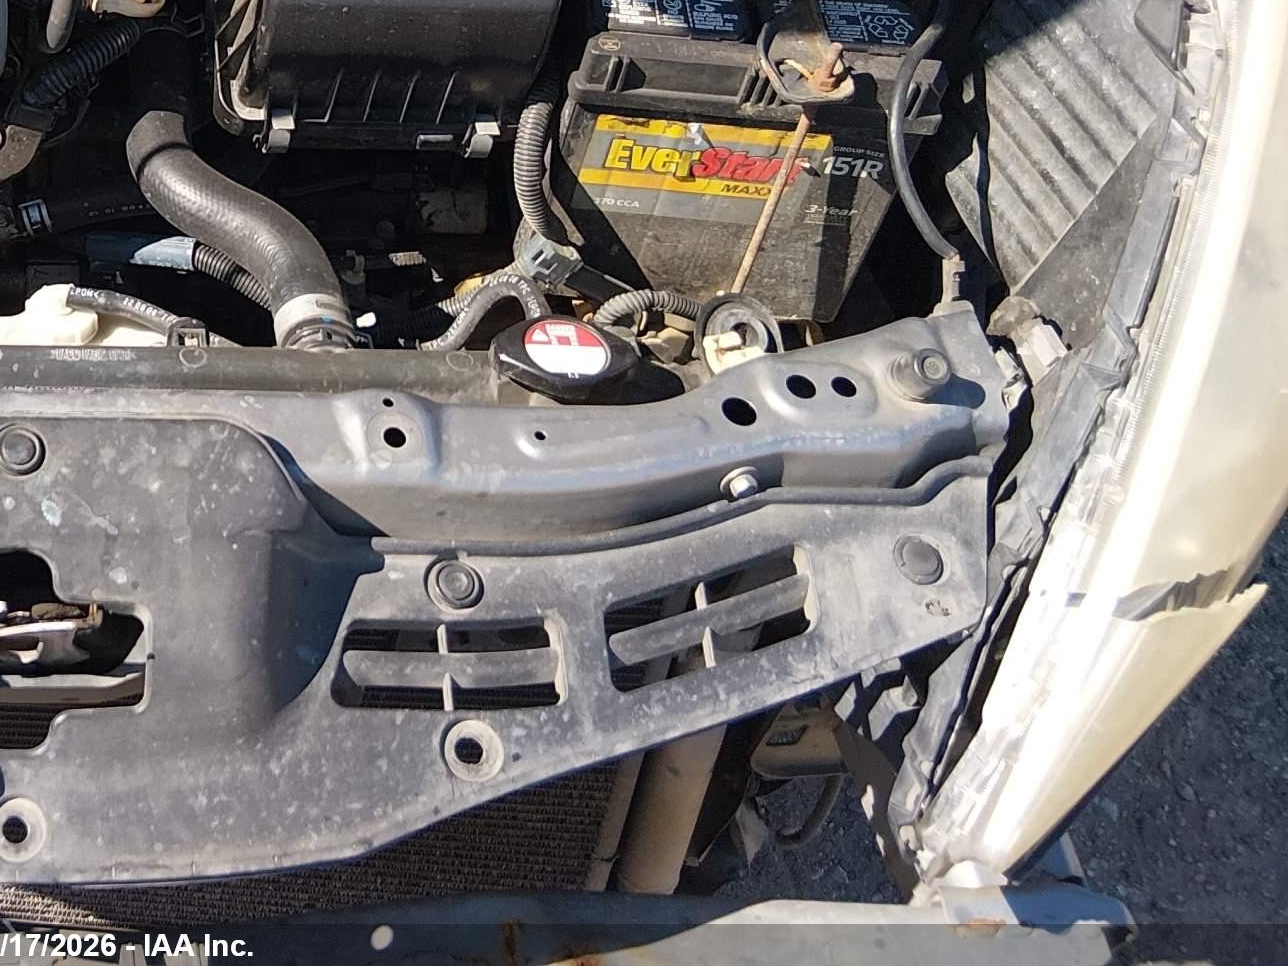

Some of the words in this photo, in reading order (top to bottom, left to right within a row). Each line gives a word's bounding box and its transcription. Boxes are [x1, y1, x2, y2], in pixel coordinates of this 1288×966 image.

[833, 146, 865, 154] GROUP
[865, 149, 886, 158] SIZE
[603, 137, 809, 185] EverStart
[822, 156, 884, 180] 151R
[616, 199, 640, 208] CCA
[805, 205, 859, 217] 3-Year
